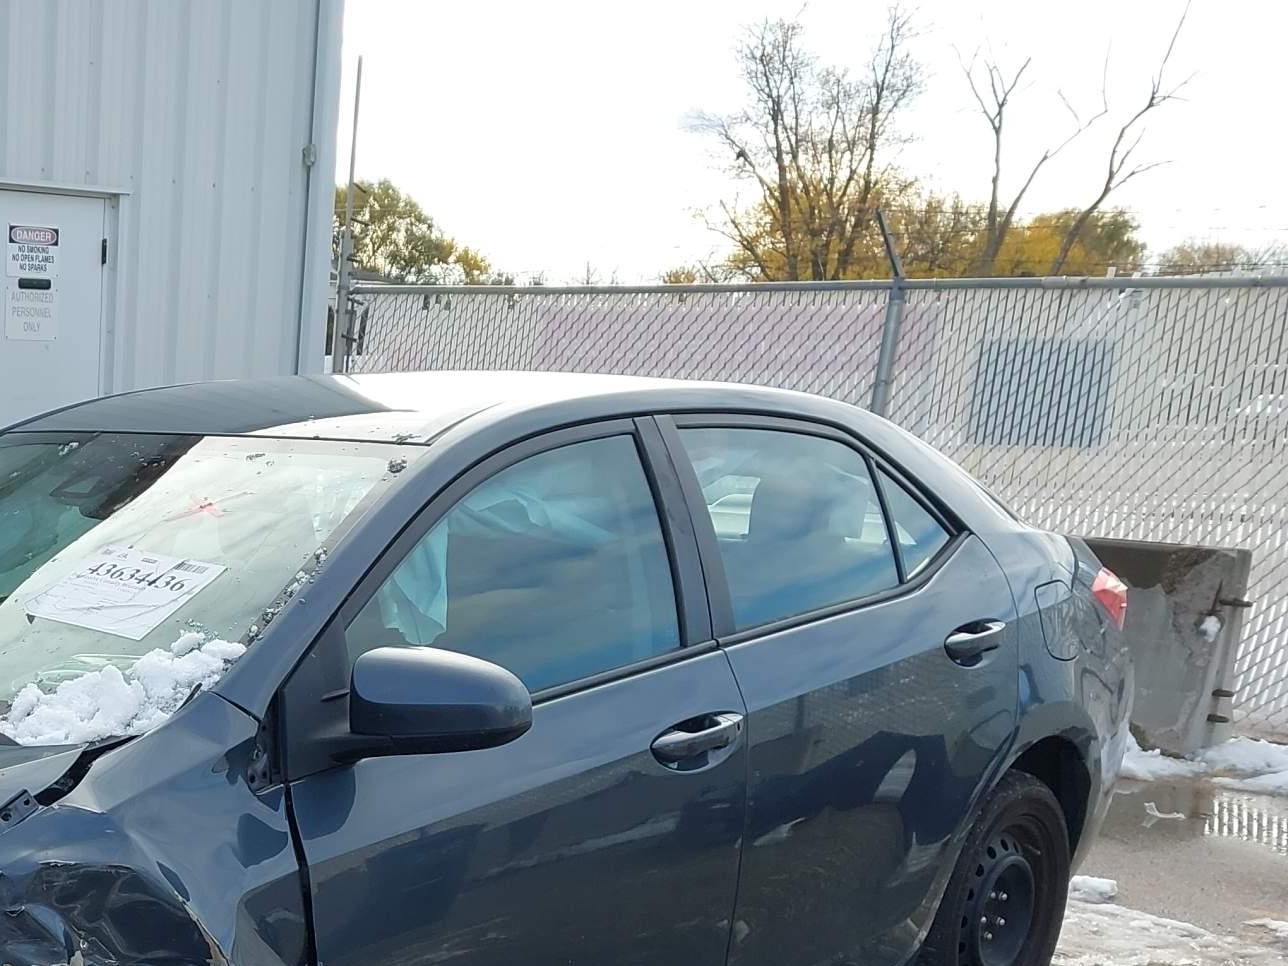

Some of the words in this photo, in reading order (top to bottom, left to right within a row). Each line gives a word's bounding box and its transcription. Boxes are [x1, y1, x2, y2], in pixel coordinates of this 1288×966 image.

[16, 230, 52, 241] DANGER
[18, 245, 26, 254] NO
[27, 245, 50, 255] SMOKING
[12, 254, 20, 262] NO
[21, 254, 35, 263] OPEN
[35, 255, 55, 264] FLAMES
[19, 263, 27, 271] NO
[27, 263, 48, 272] SPARKS
[11, 291, 54, 304] AUTHORIZED
[11, 306, 52, 319] PERSONNEL
[24, 321, 41, 333] ONLY
[87, 562, 192, 591] 43634436
